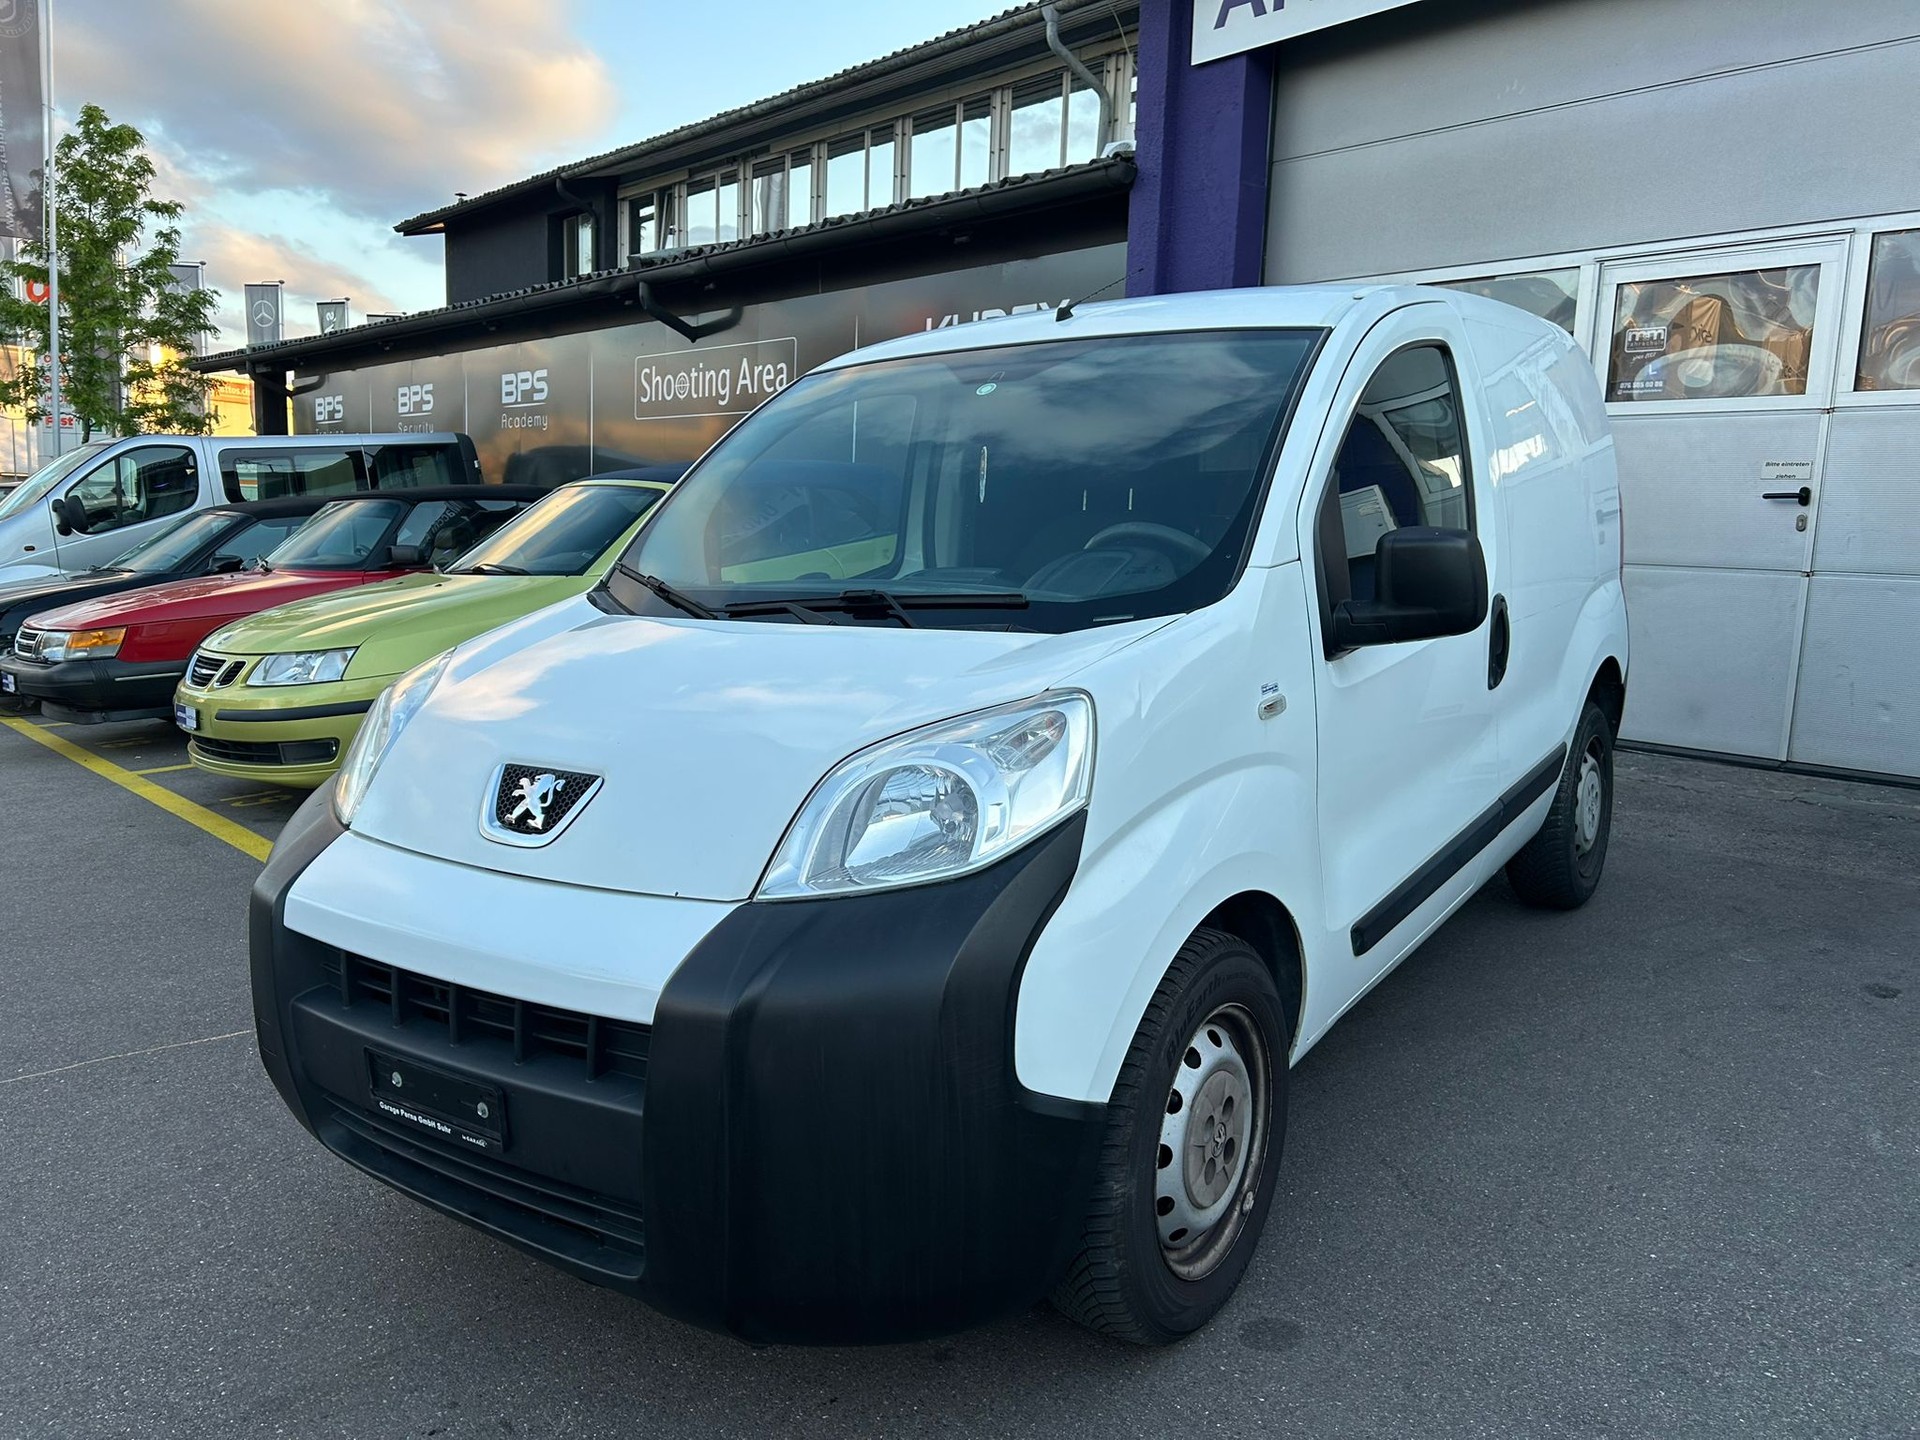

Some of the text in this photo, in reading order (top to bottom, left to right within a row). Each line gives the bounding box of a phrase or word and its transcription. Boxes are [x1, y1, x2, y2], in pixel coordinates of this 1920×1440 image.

[501, 368, 548, 404] BPS
[640, 357, 787, 406] Shooting Area
[315, 395, 344, 421] BPS
[397, 383, 434, 413] BPS
[501, 412, 548, 431] Academy
[379, 1101, 400, 1115] Garage
[418, 1116, 437, 1128] GmbH
